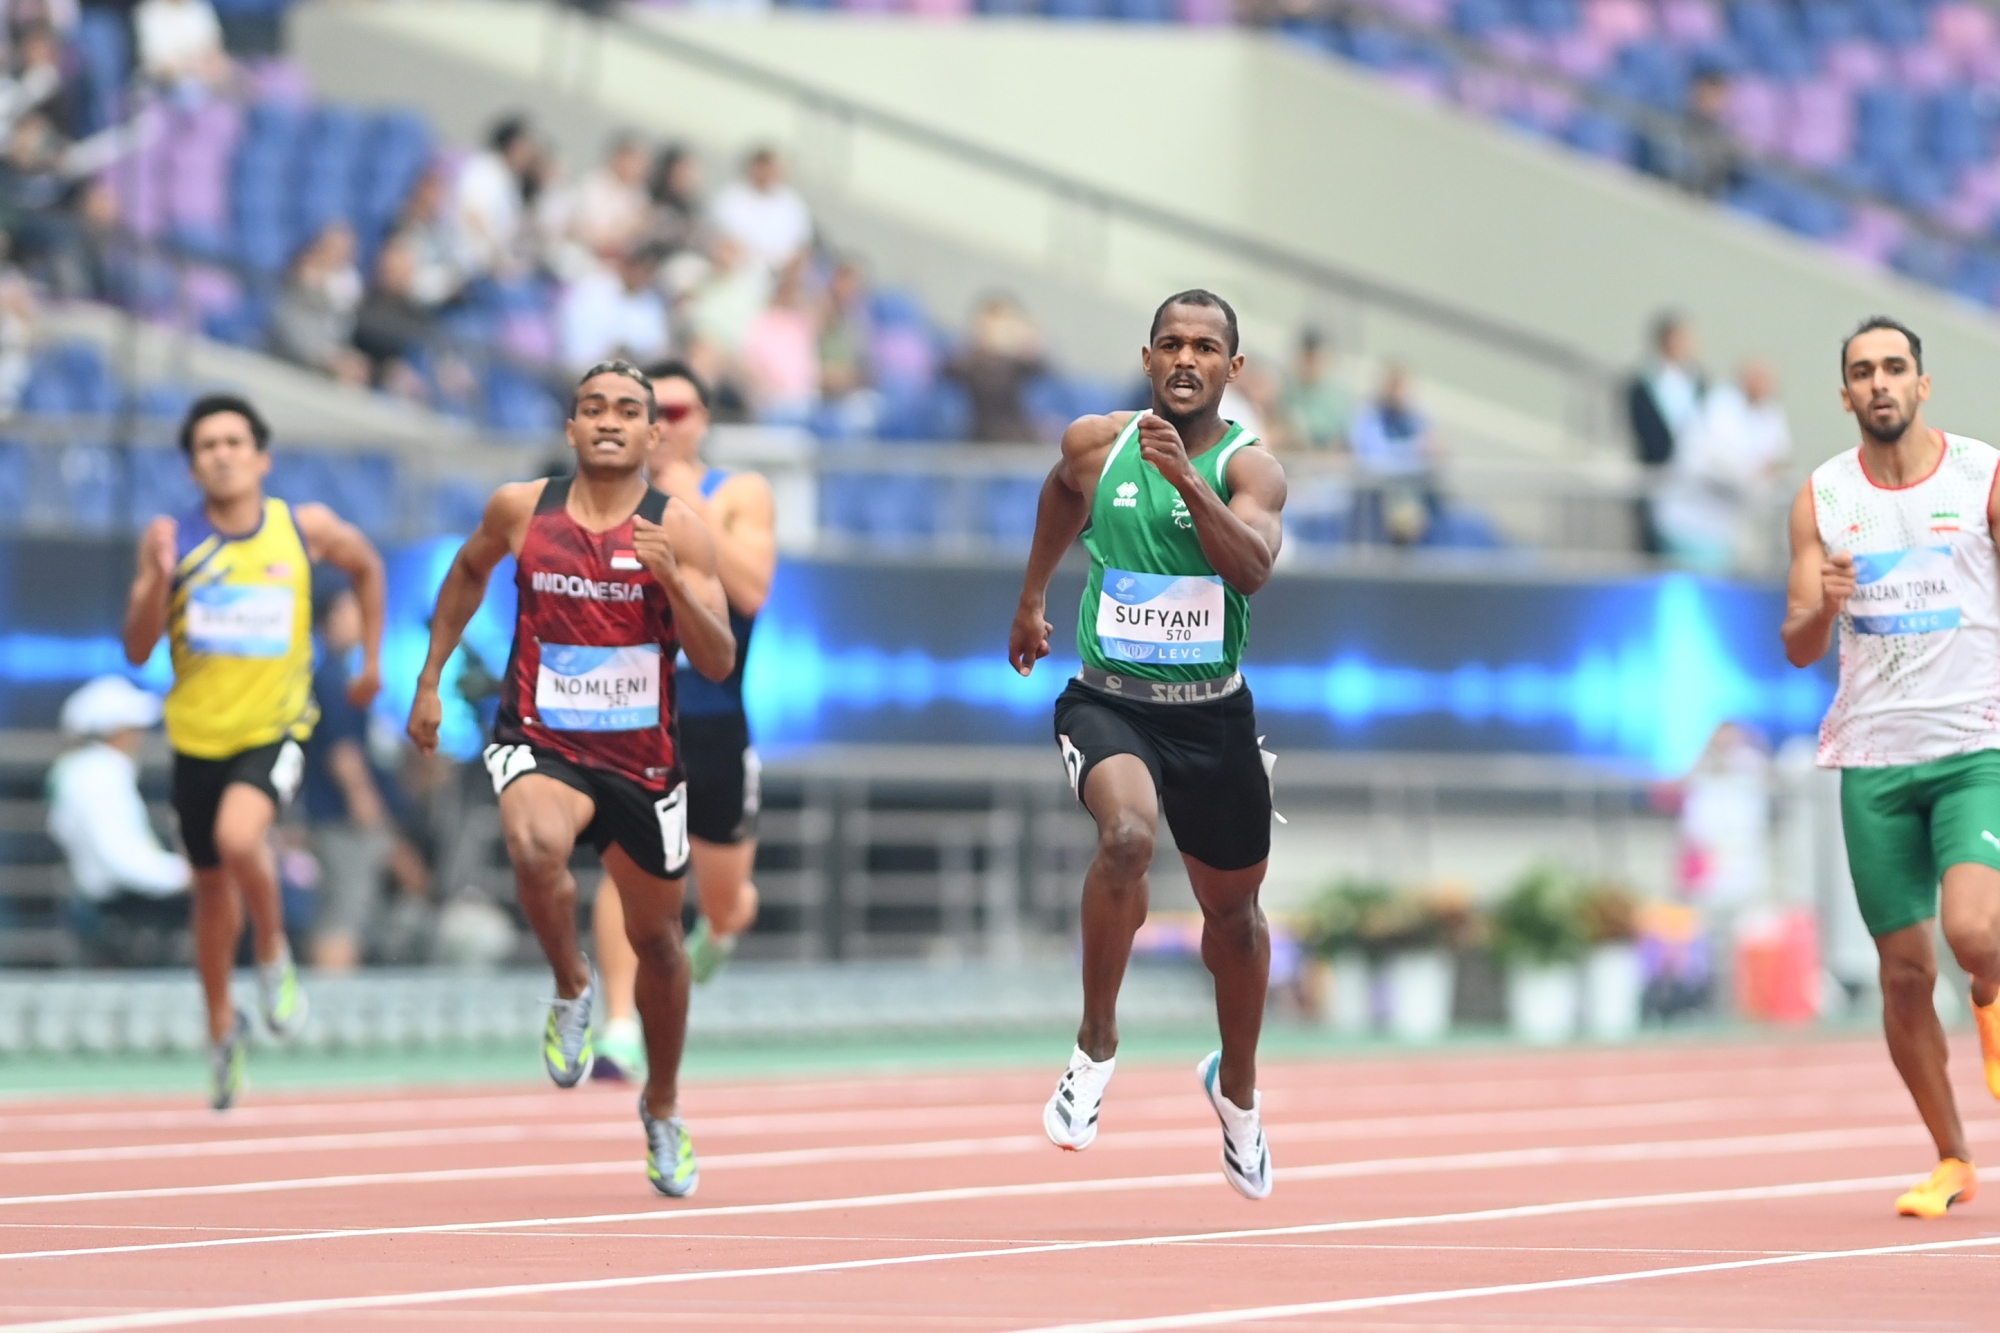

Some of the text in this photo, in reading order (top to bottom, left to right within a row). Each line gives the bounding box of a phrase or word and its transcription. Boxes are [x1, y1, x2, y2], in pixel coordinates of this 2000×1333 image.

[532, 571, 644, 602] INDONESIA
[1115, 605, 1209, 627] SUFYANI
[1899, 614, 1939, 630] LEVC
[1166, 629, 1192, 641] 570
[1158, 648, 1201, 659] LEVC
[554, 676, 648, 695] NOMLENI
